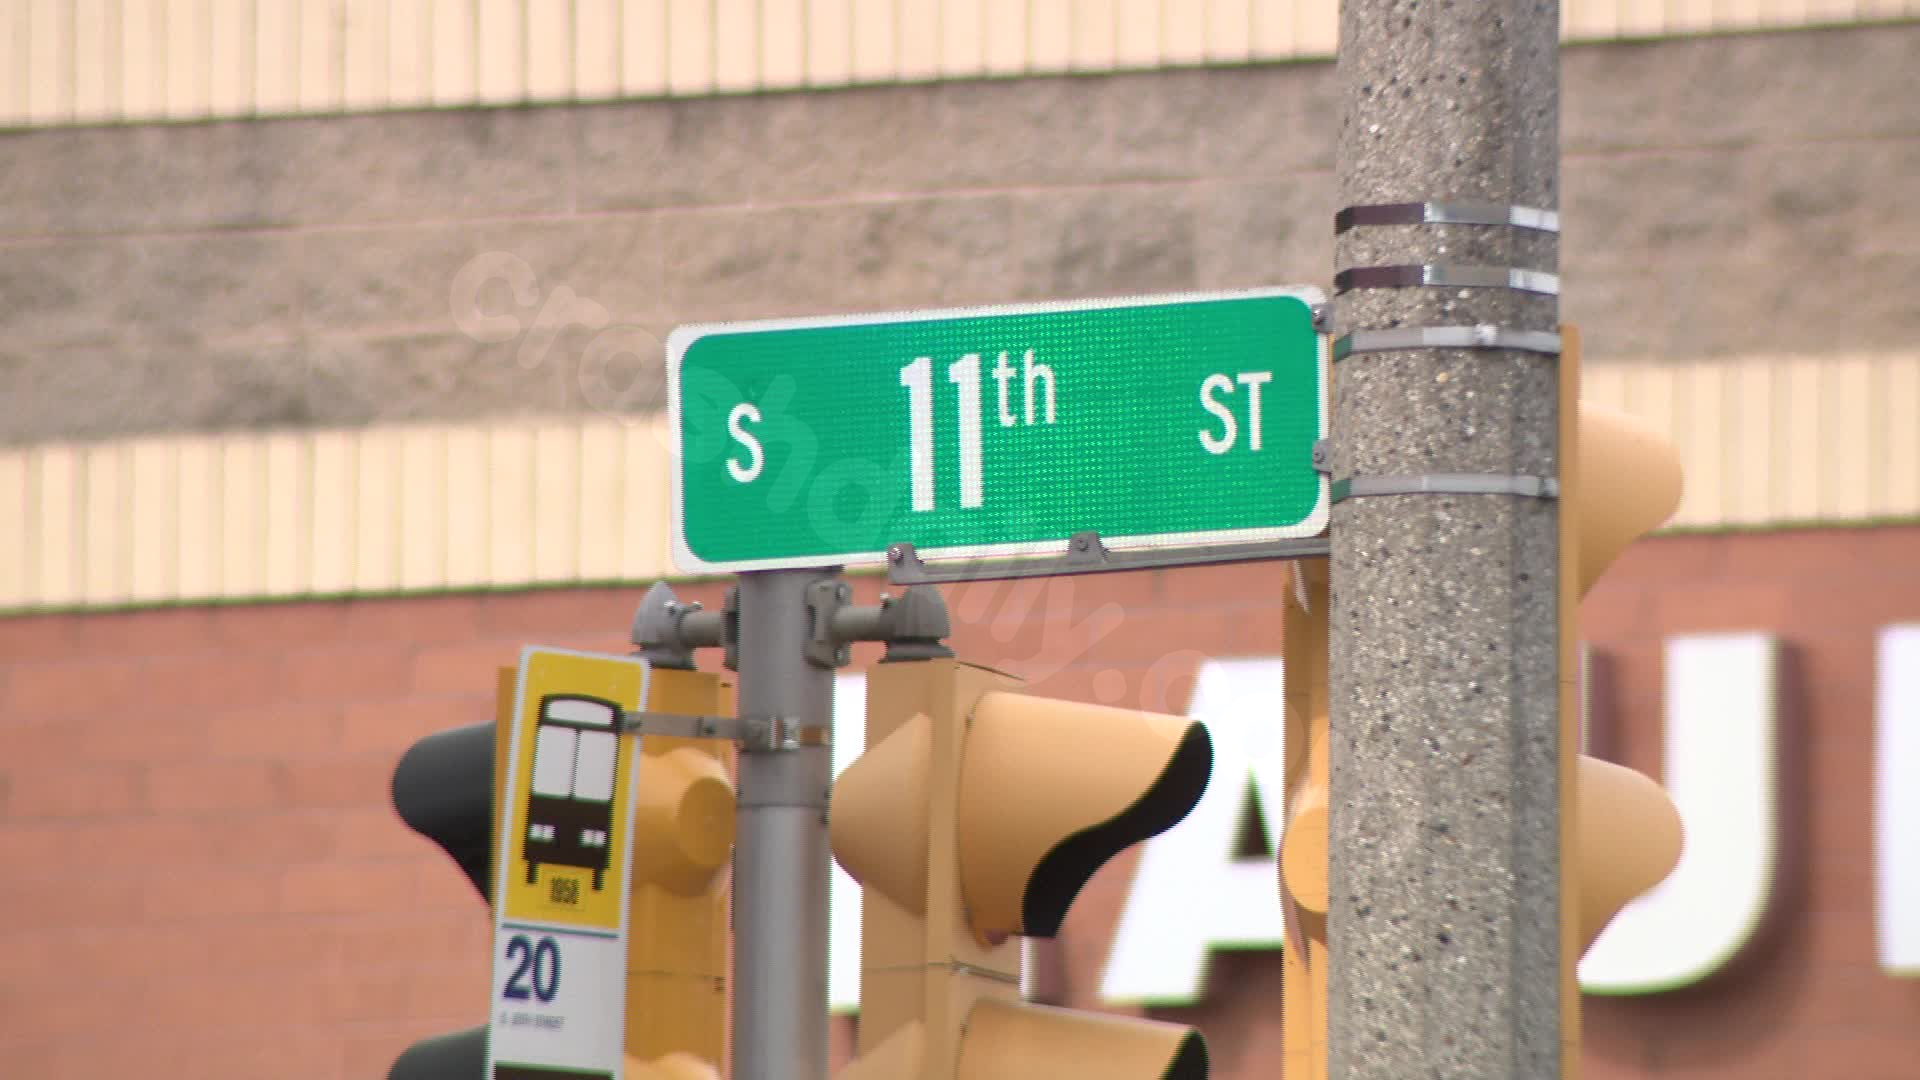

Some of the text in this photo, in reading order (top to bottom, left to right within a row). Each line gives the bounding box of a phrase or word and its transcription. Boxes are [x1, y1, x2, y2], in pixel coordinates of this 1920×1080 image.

[726, 348, 1273, 512] S 11th ST
[503, 934, 562, 1003] 20
